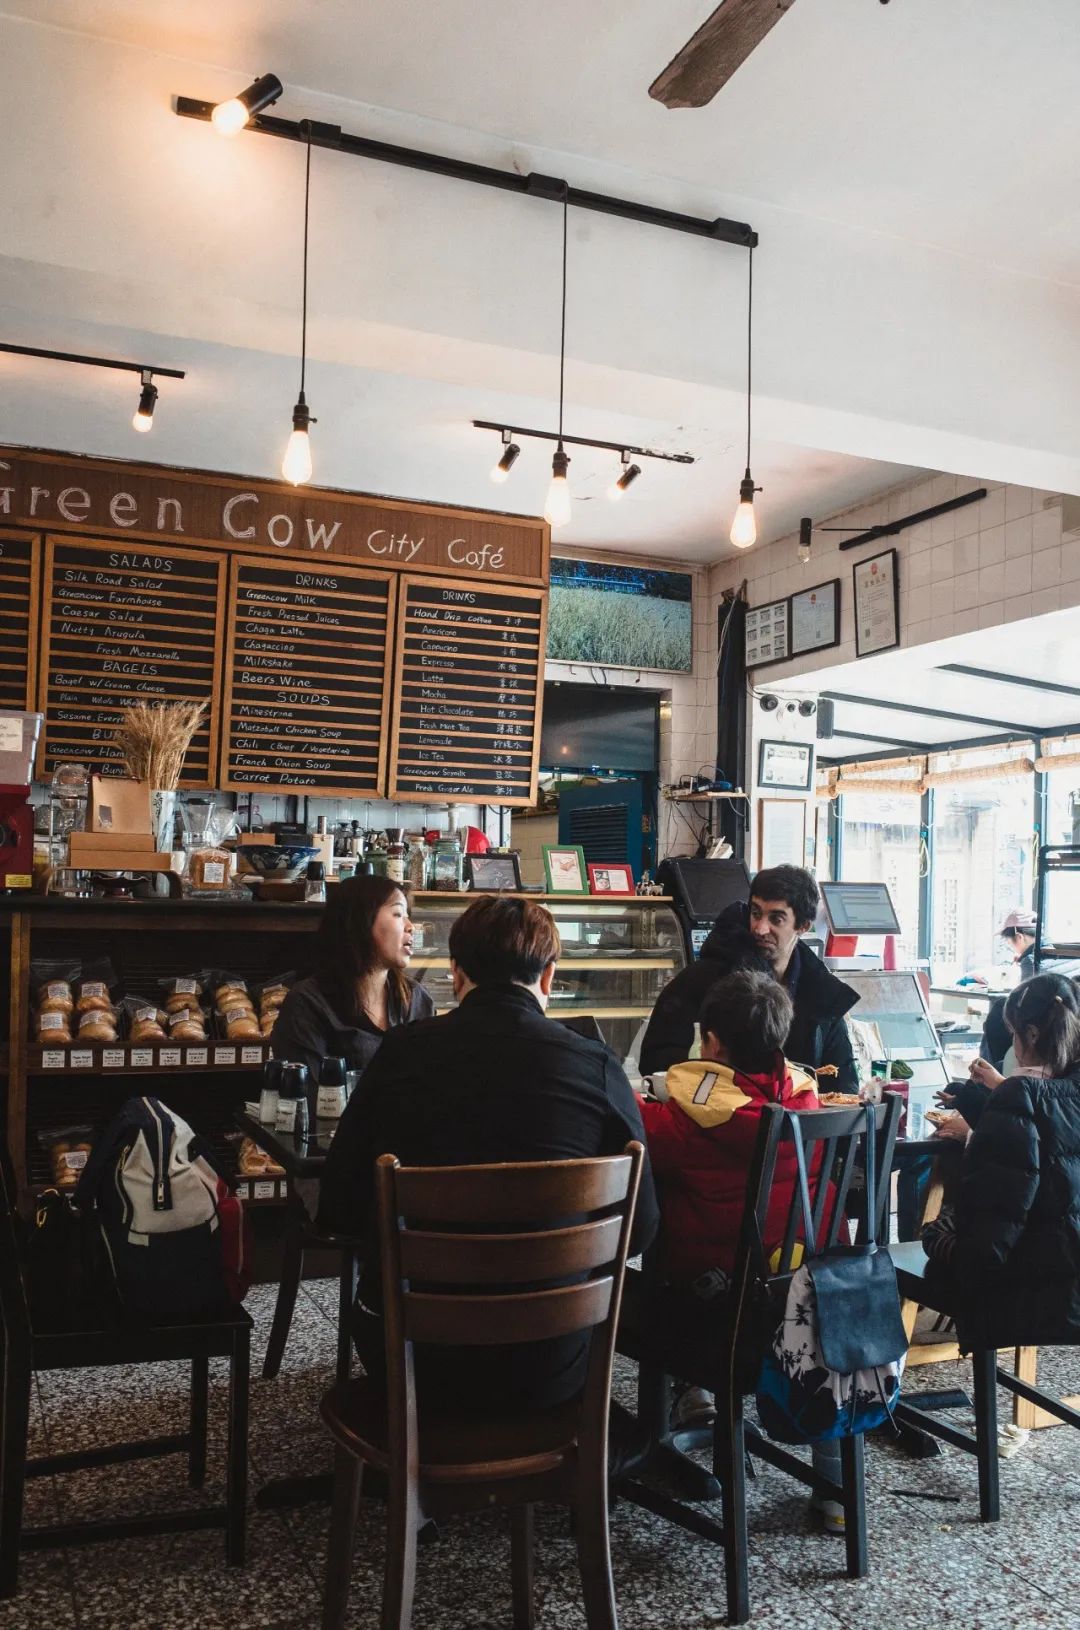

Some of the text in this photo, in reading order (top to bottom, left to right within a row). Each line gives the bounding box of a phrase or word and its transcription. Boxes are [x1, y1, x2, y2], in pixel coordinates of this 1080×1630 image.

[223, 493, 341, 550] Cow
[367, 530, 424, 562] City
[447, 539, 505, 571] Café
[110, 554, 174, 571] SALADS
[65, 571, 162, 589] Silk Road Salad
[295, 574, 338, 589] DRINKS
[59, 588, 162, 606] Greencow Farmhouse
[246, 590, 316, 605] Greencow Milk
[443, 591, 475, 603] DRINKS
[62, 606, 143, 622] Caesar Salad
[248, 606, 340, 625] Fresh Pressed Juices
[414, 608, 439, 619] Hand
[444, 610, 461, 622] Drip
[61, 623, 145, 640] Nutty Arugula
[245, 623, 304, 636] Chaga Latte
[421, 625, 457, 637] Americano
[97, 644, 180, 660] Fresh Mozzarella
[244, 640, 295, 652] Chagaccino
[103, 661, 159, 675] BAGELS
[243, 656, 293, 668] Milkshake
[55, 675, 166, 693] Bagel w/ Cream Cheese
[279, 676, 312, 688] Wine
[422, 672, 444, 683] Latte
[276, 692, 330, 706] SOUPS
[421, 689, 446, 699] Mocha
[420, 704, 474, 716] Hot Chocolate
[420, 720, 437, 729] Fresh
[459, 723, 471, 731] Tea
[285, 726, 317, 735] Chicken
[319, 728, 342, 739] Soup
[235, 739, 258, 749] Chili
[418, 736, 452, 746] Lemonade
[50, 744, 95, 755] Greencow
[418, 751, 444, 760] Ice Tea
[235, 755, 331, 770] French Onion Soup
[233, 772, 316, 785] Carrot Potato
[462, 785, 474, 794] Ale
